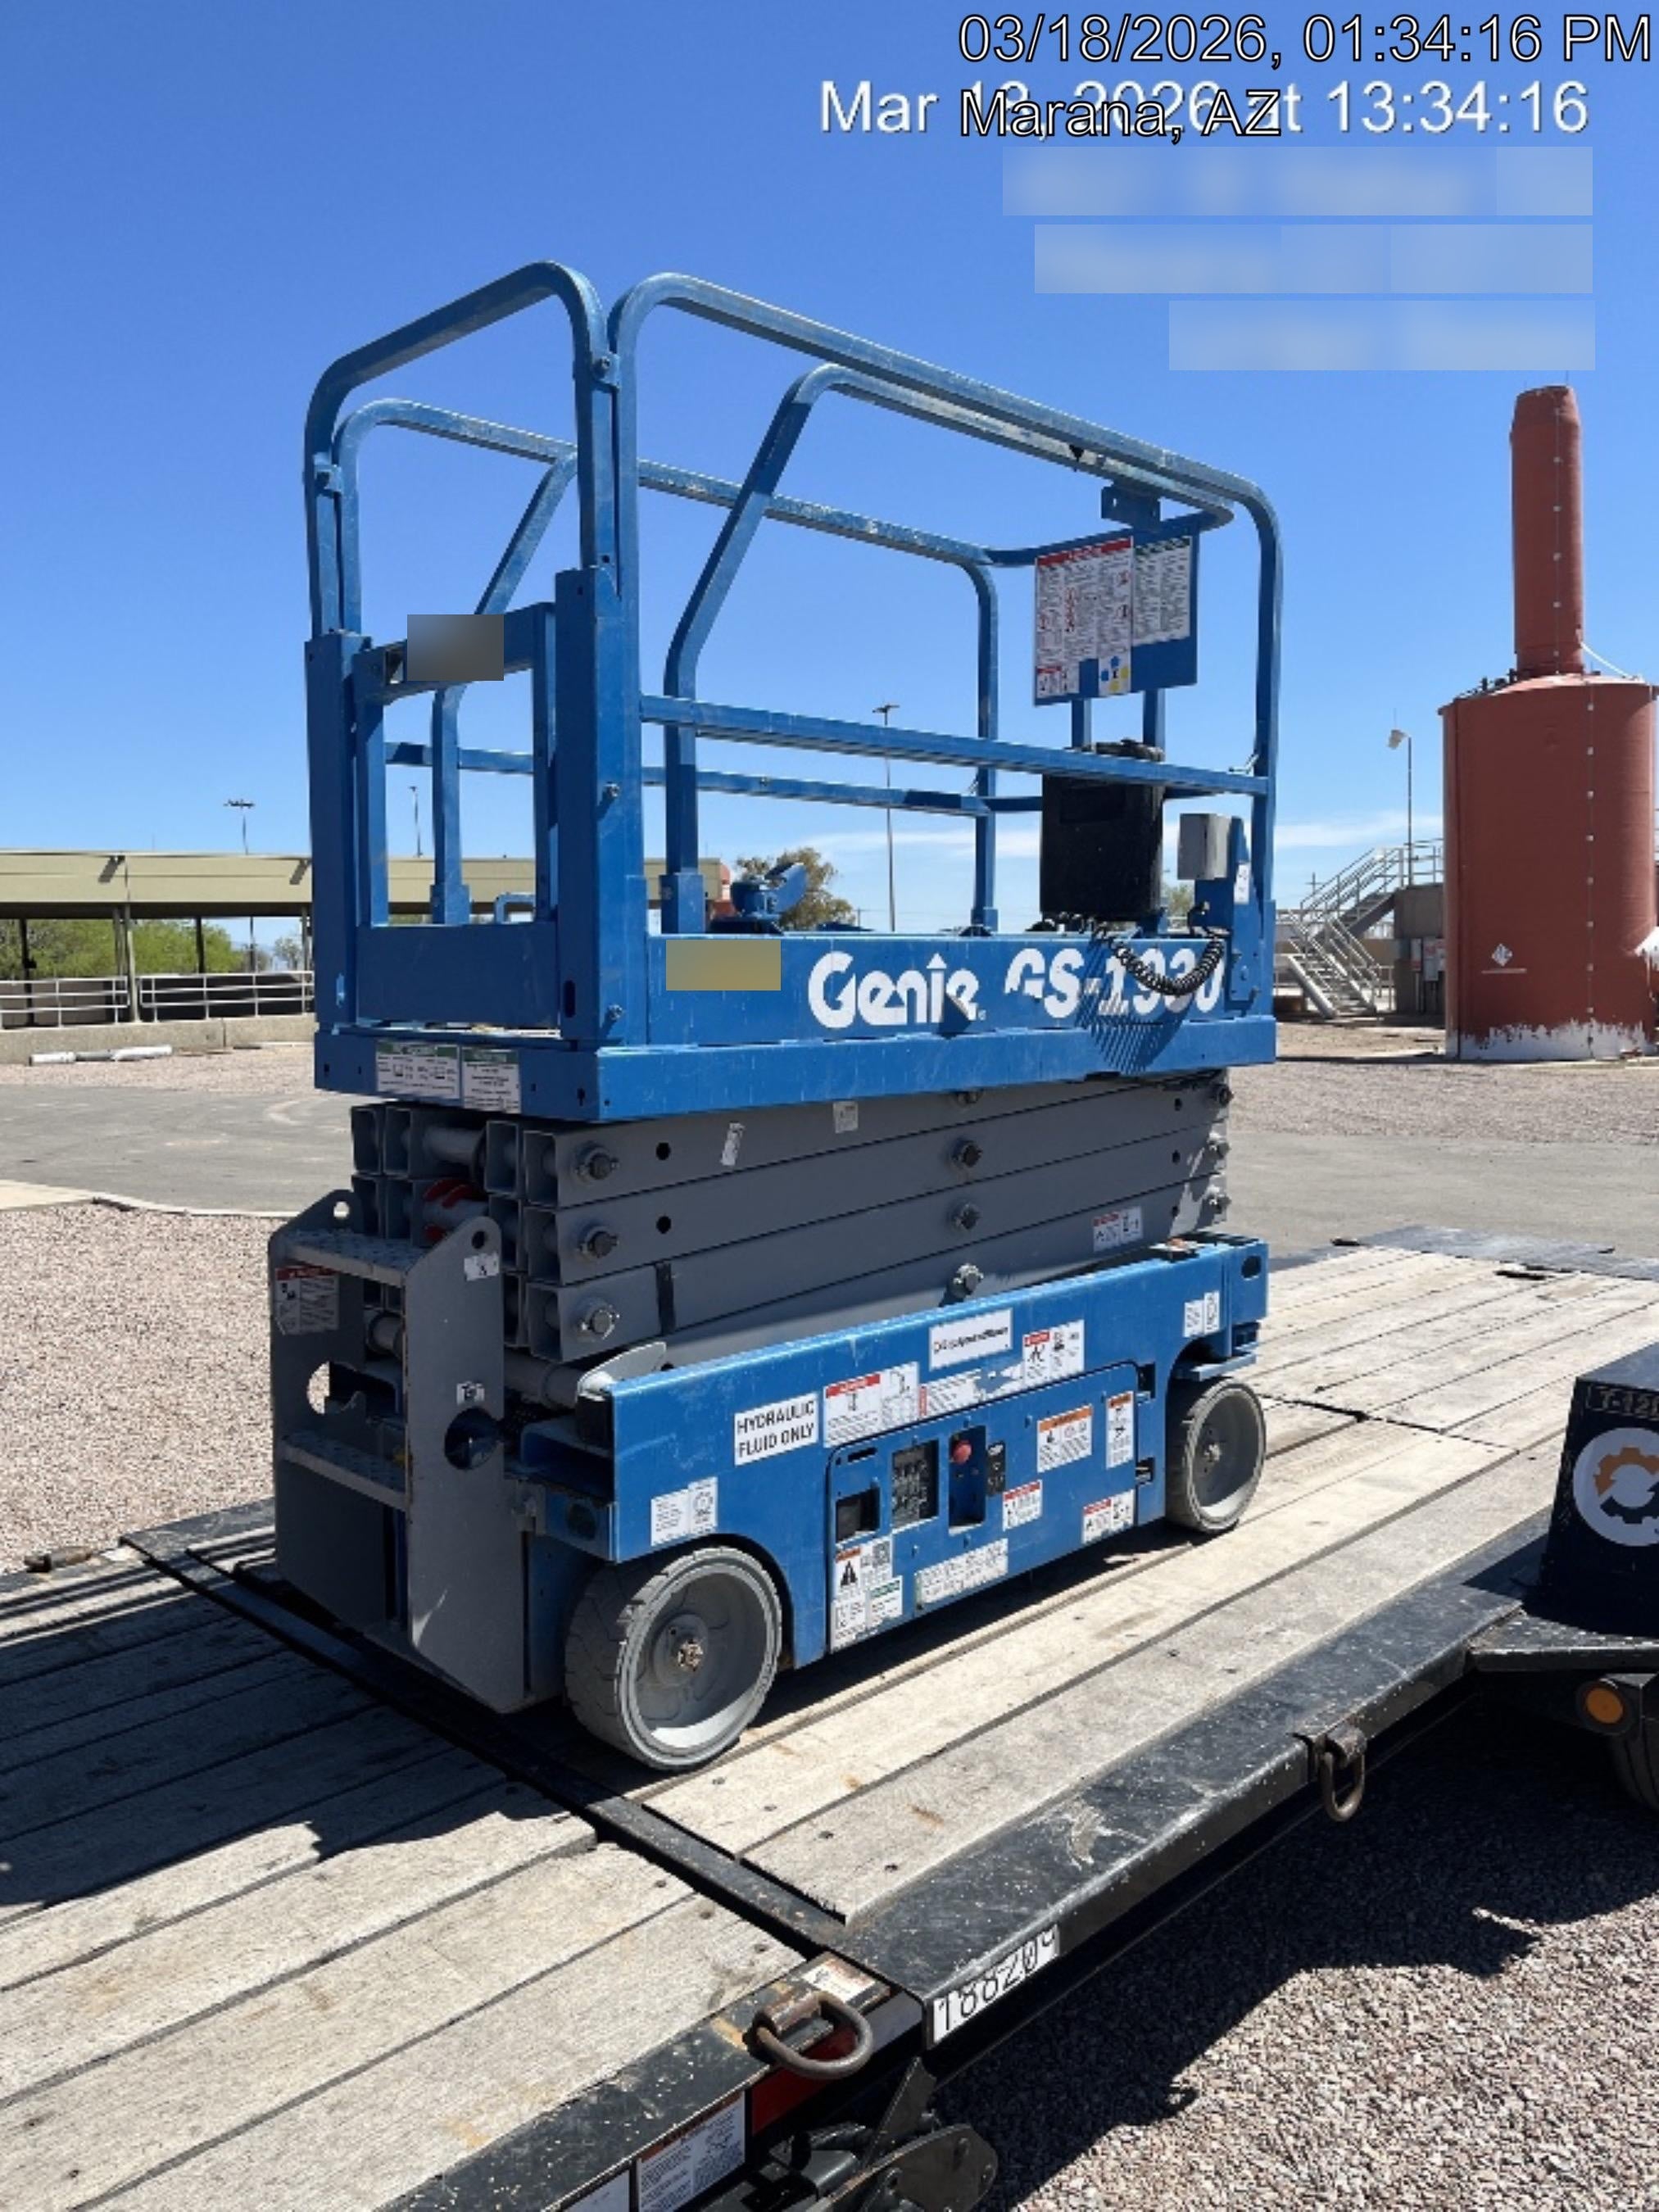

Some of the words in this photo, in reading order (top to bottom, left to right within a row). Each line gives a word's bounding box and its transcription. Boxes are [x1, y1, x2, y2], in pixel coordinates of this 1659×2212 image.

[808, 951, 979, 1028] Genie
[737, 1400, 814, 1435] HYDRAULIC
[739, 1433, 777, 1458] FLUID
[781, 1422, 814, 1444] ONLY
